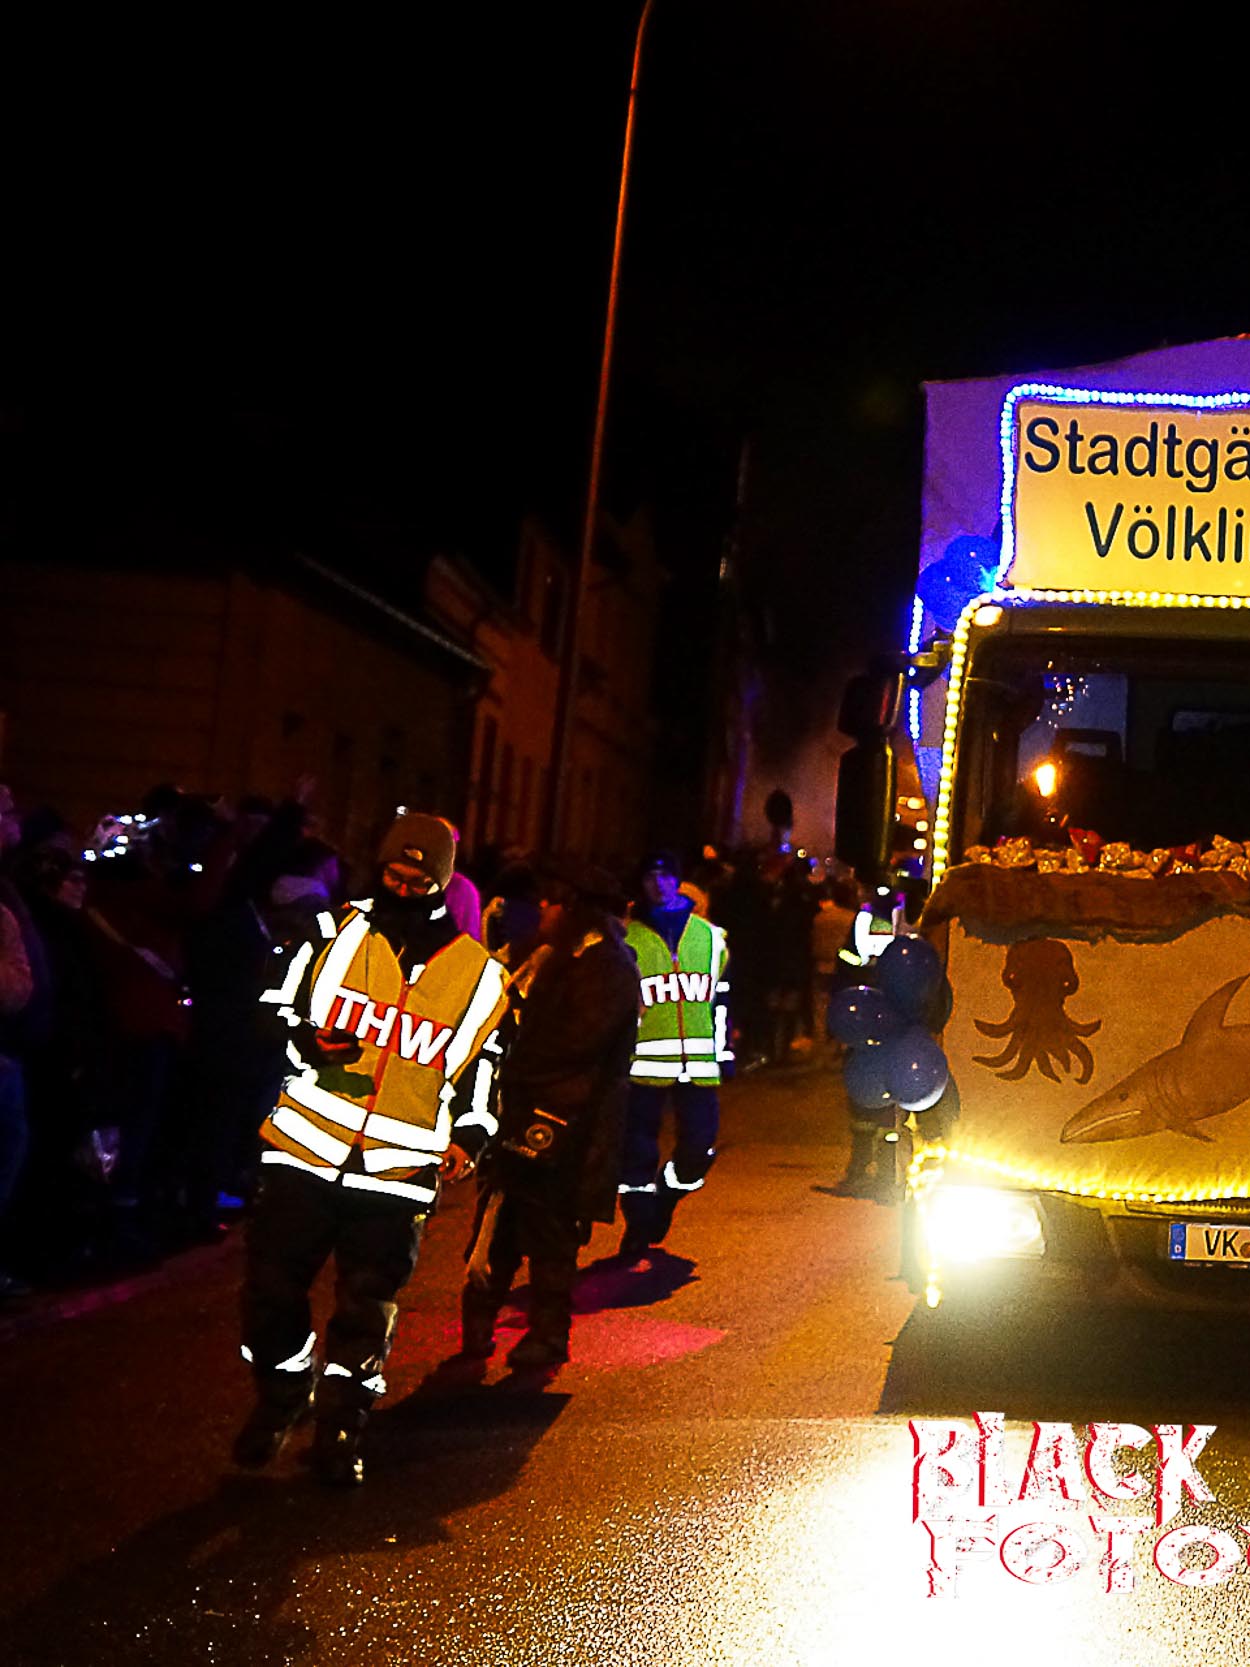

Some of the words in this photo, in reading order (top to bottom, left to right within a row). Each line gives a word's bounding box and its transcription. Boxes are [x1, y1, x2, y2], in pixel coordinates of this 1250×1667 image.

[639, 972, 711, 1008] THW
[334, 985, 454, 1066] THW
[1204, 1230, 1239, 1257] VK
